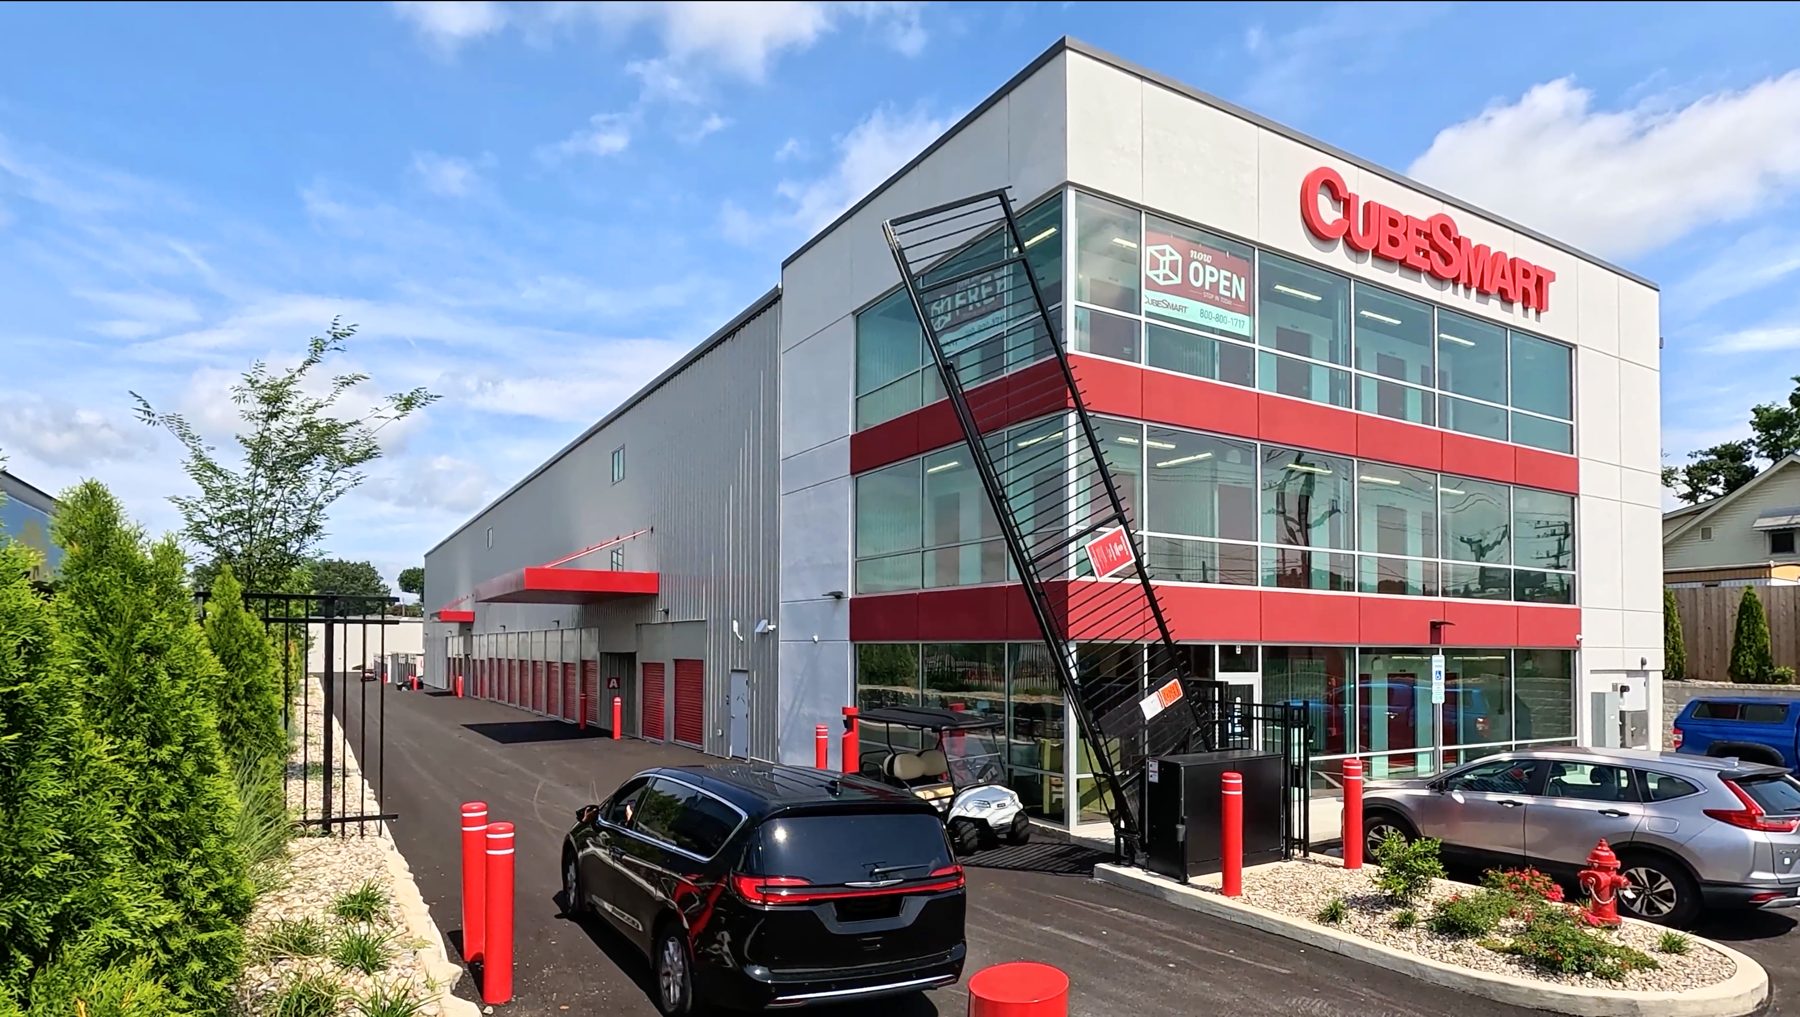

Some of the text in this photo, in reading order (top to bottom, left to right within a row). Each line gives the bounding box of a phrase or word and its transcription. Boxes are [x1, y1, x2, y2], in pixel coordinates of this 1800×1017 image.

[1190, 249, 1212, 263] now
[1189, 261, 1246, 302] OPEN
[1199, 308, 1246, 329] 800-800-1717
[609, 678, 618, 688] A
